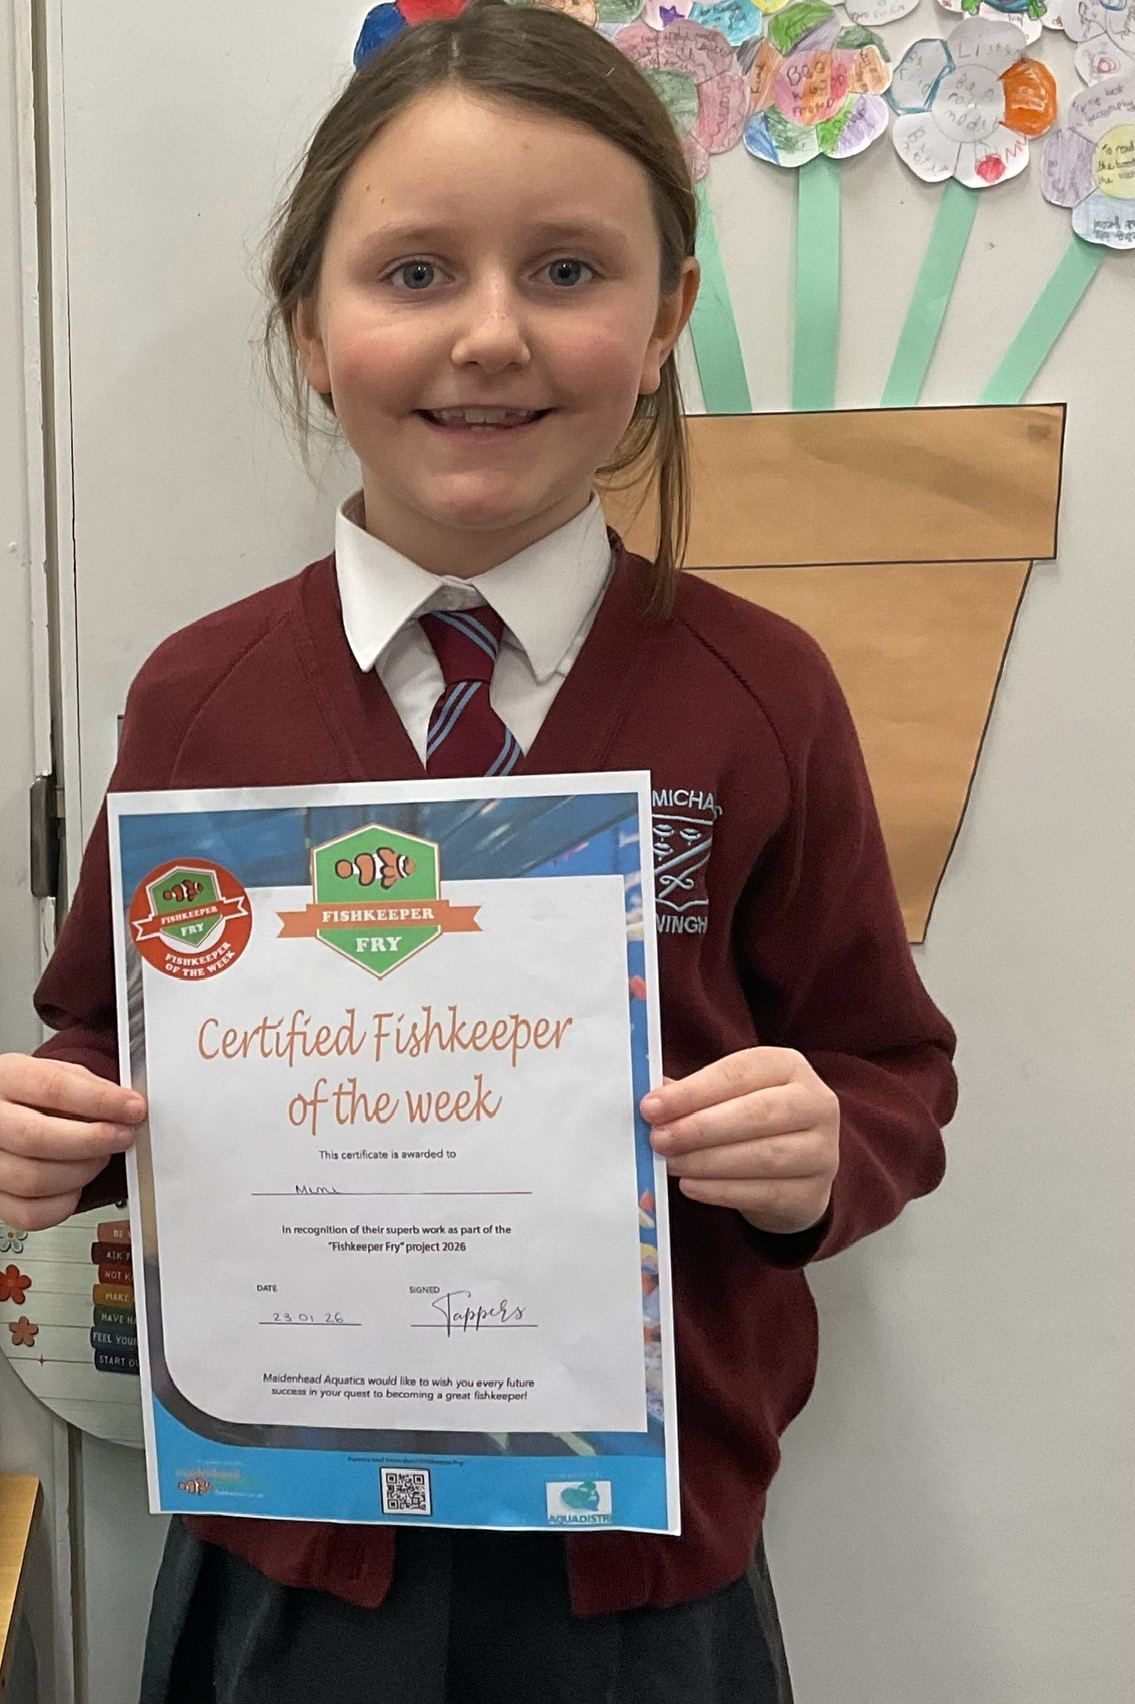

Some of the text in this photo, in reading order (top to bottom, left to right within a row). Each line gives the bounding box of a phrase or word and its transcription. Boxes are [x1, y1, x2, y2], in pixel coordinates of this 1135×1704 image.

[160, 906, 218, 925] FISHKEEPER
[322, 908, 435, 923] FISHKEEPER
[180, 923, 204, 936] FRY
[356, 936, 402, 952] FRY
[165, 942, 231, 966] FISHKEEPER
[165, 951, 236, 977] OF THE WEEK
[198, 1004, 574, 1068] Certified Fishkeeper
[288, 1072, 503, 1136] of the week
[319, 1149, 456, 1160] This certificate is awarded to
[114, 1230, 124, 1238] BE
[282, 1225, 512, 1236] In recognition of their superb work as part of the
[406, 1242, 440, 1253] project
[442, 1242, 466, 1252] 2026
[104, 1270, 122, 1280] NOT
[410, 1286, 440, 1294] SIGNED
[106, 1292, 128, 1302] MAKE
[101, 1313, 137, 1325] HAVE HA
[272, 1312, 292, 1322] 23
[324, 1312, 344, 1324] 26
[432, 1290, 527, 1338] Tappers
[93, 1332, 112, 1343] FEEL
[100, 1354, 140, 1368] START OV
[263, 1373, 534, 1390] Maidenhead Aquatics would like to wish you every future
[271, 1388, 306, 1396] success
[309, 1388, 318, 1396] in
[320, 1390, 342, 1399] your
[344, 1390, 370, 1400] quest
[374, 1390, 383, 1398] to
[386, 1390, 434, 1401] becoming
[446, 1392, 470, 1402] great
[474, 1390, 528, 1402] fishkeeper!
